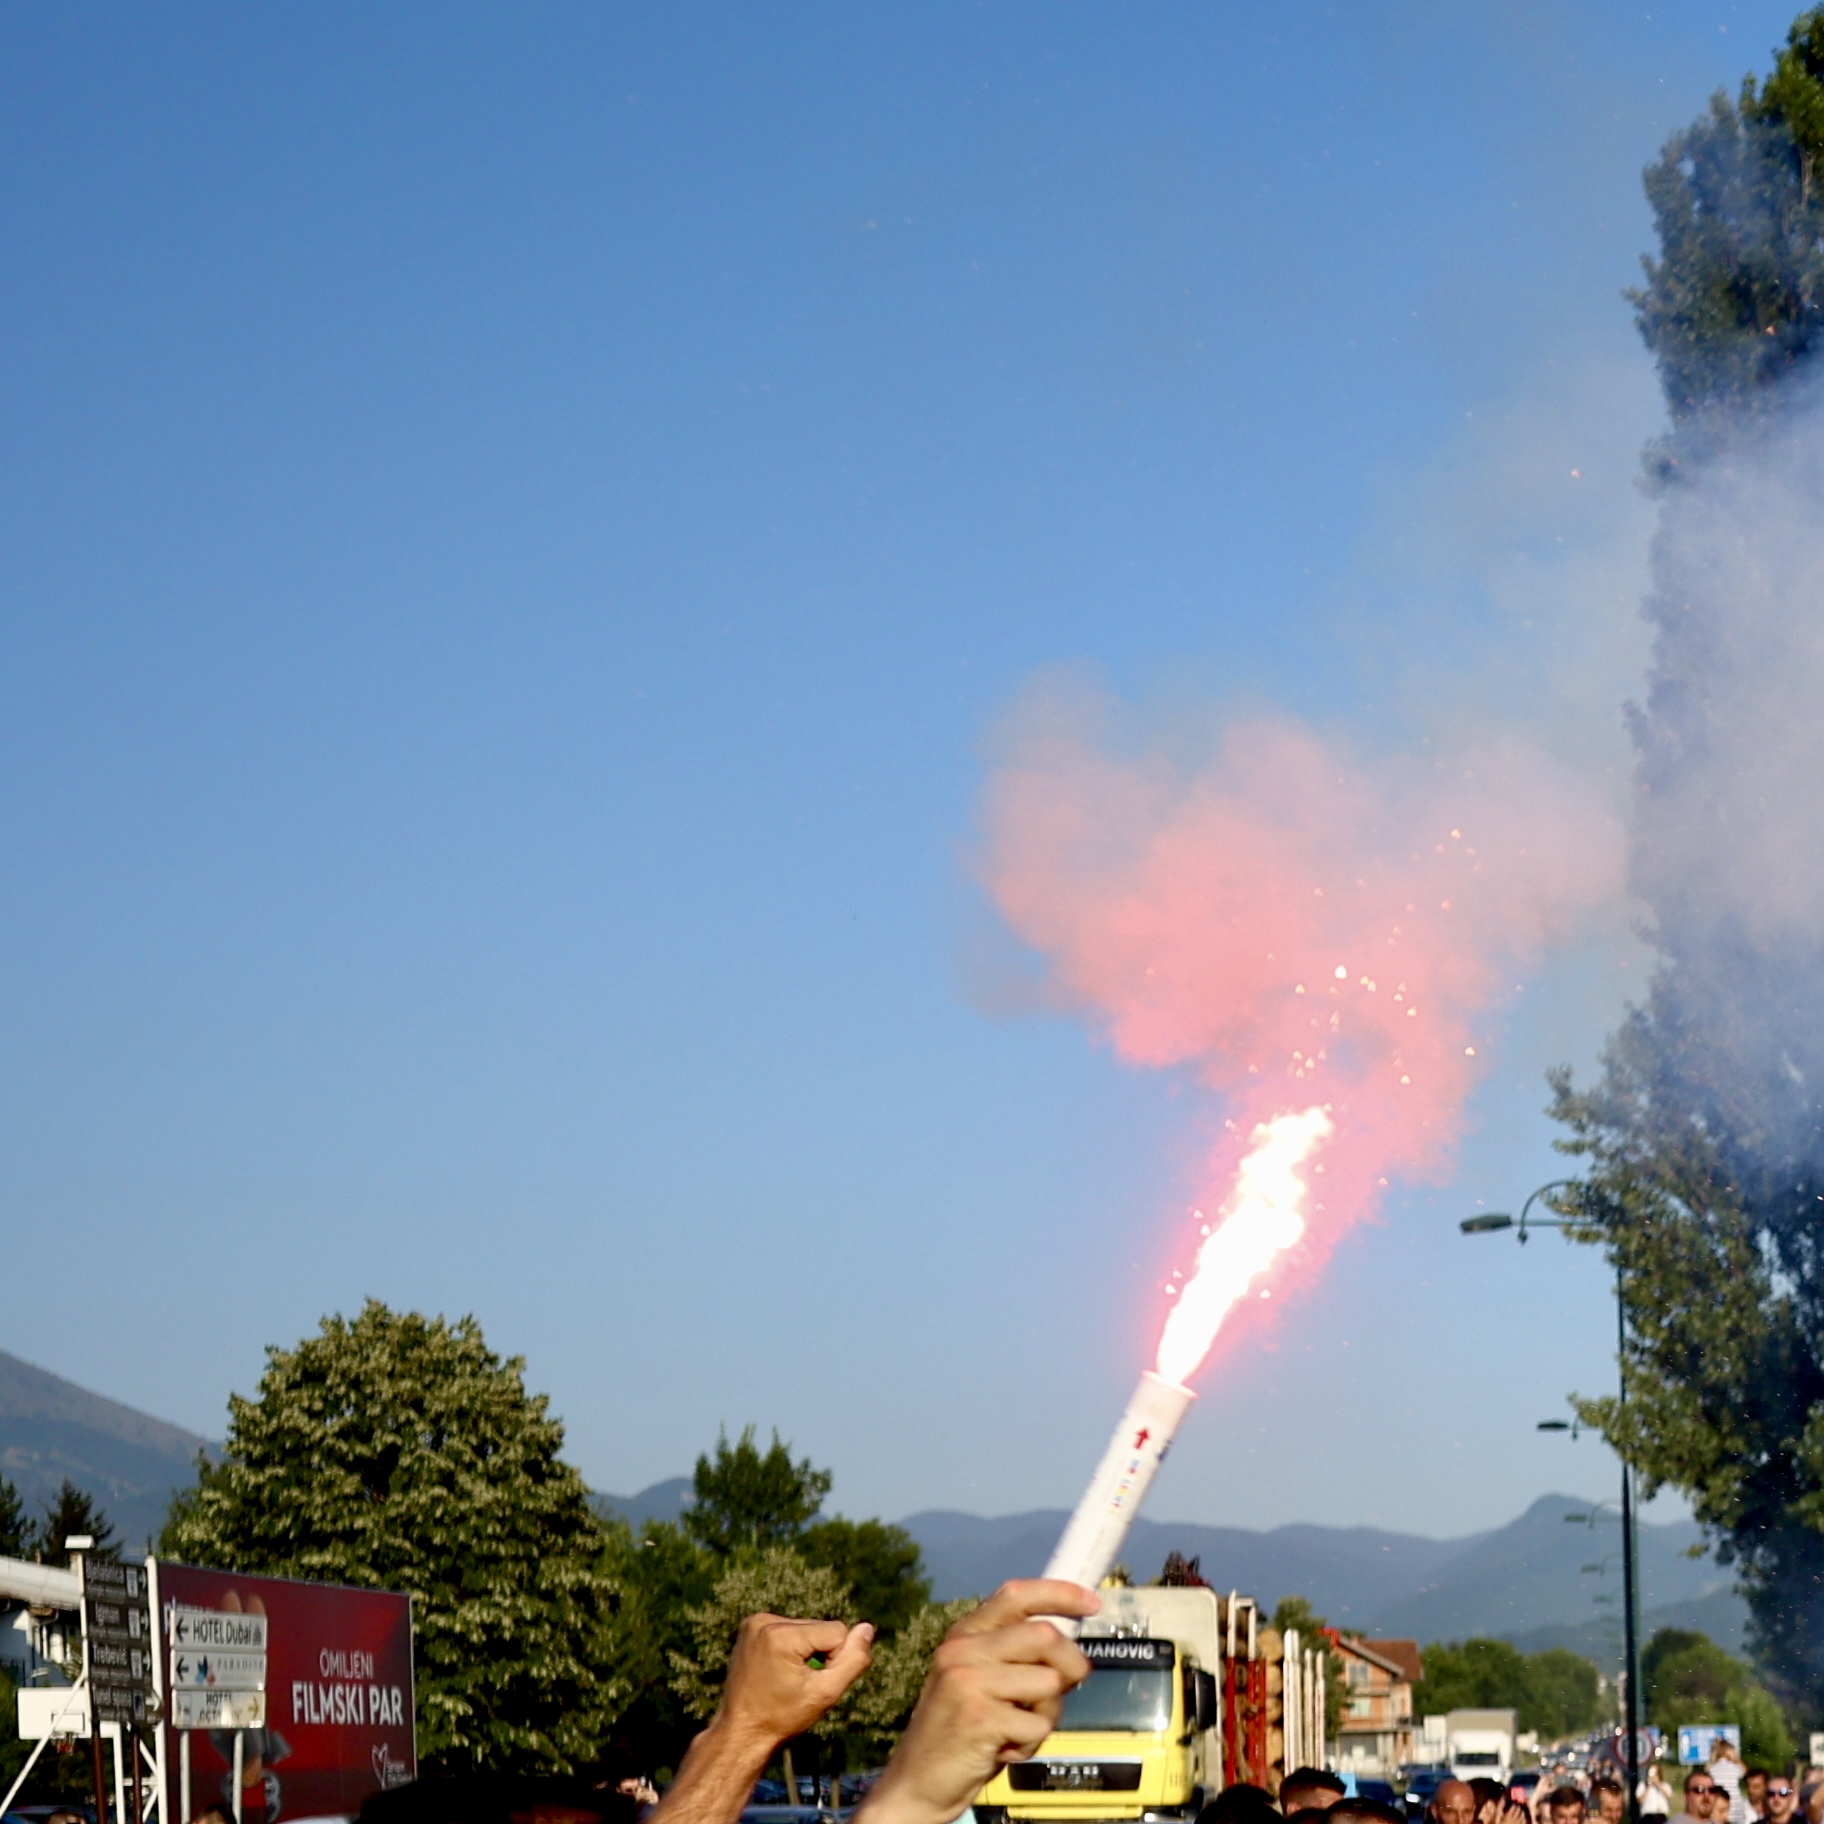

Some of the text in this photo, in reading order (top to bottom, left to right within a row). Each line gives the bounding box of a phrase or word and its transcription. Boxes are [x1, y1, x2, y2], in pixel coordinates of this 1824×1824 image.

[193, 1620, 252, 1645] HOTEL Dubai
[320, 1648, 374, 1679] OMILJENI
[292, 1681, 403, 1726] FILMSKI PAR
